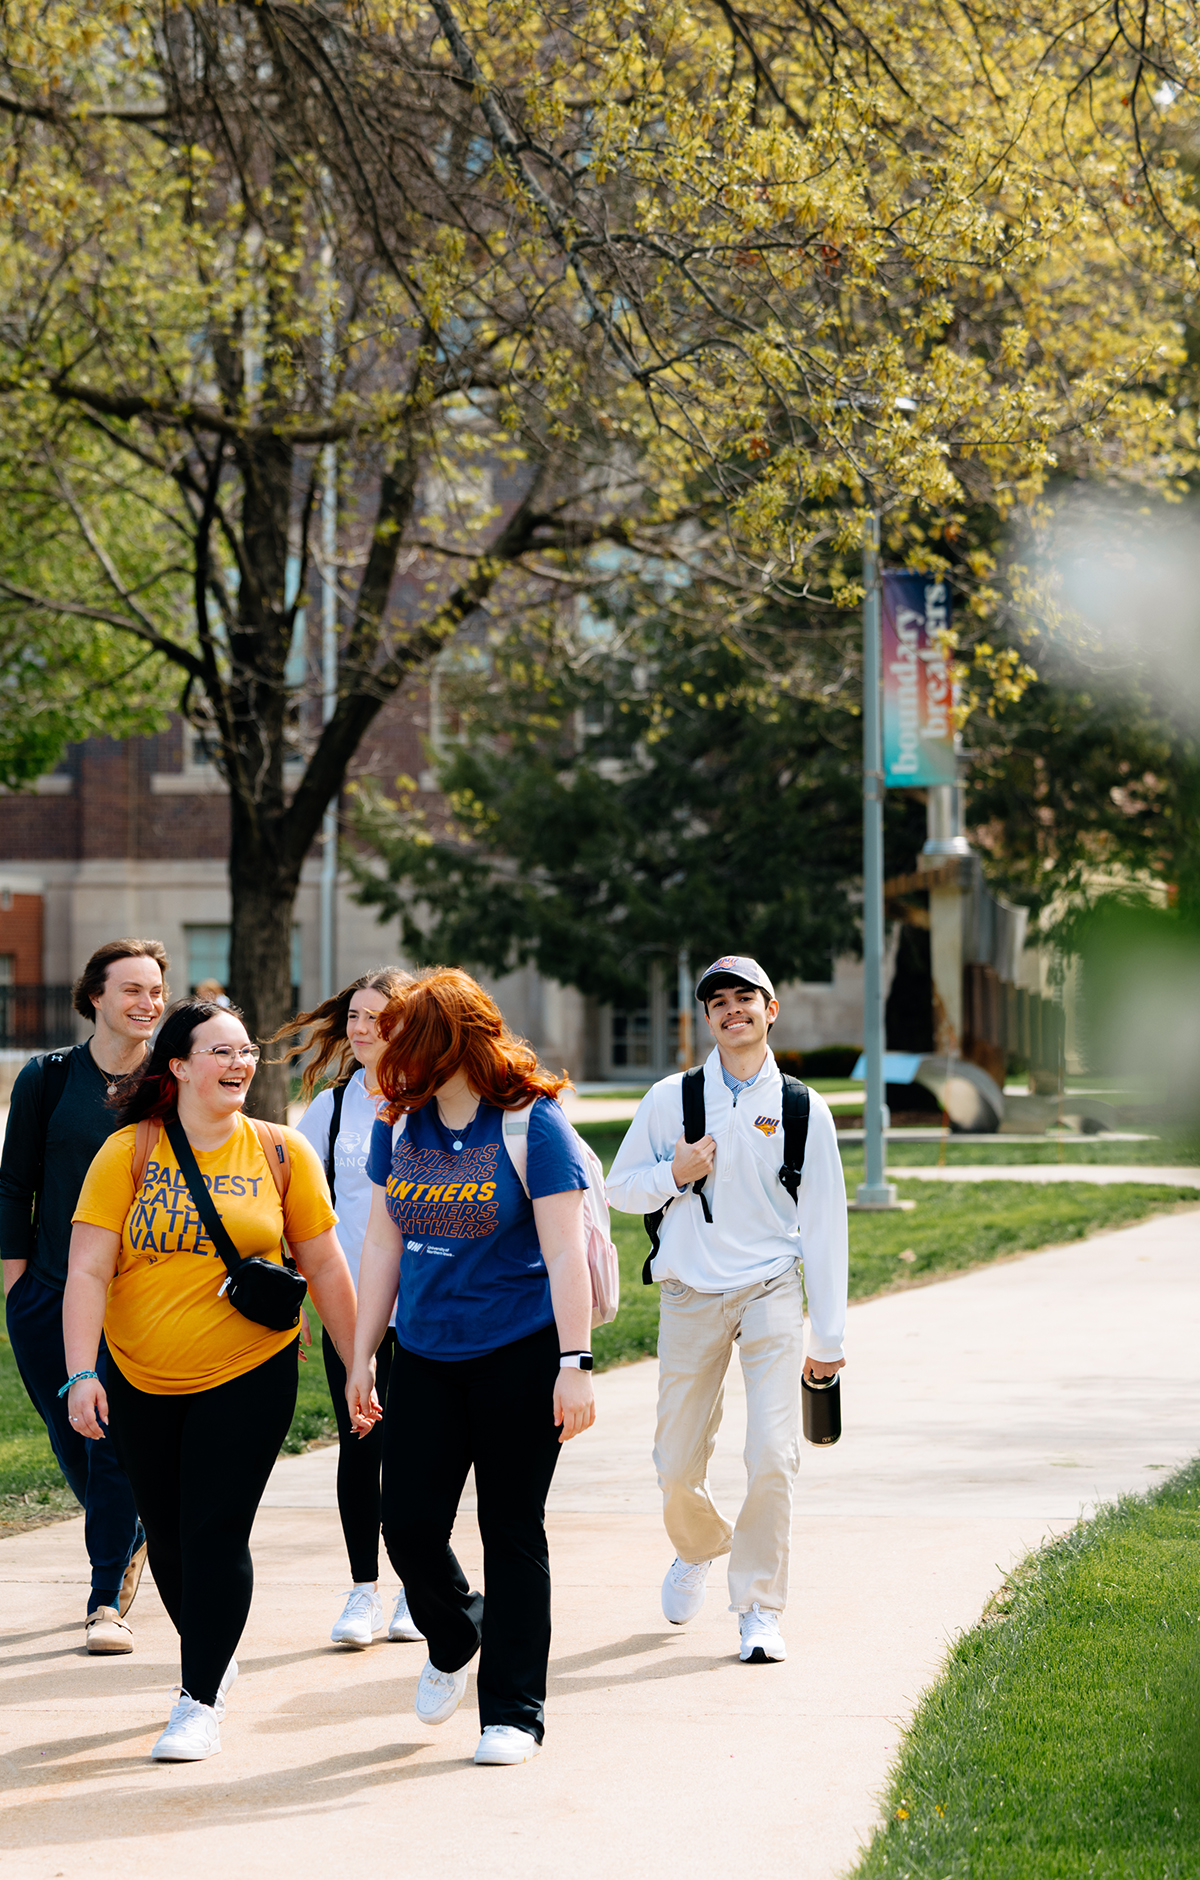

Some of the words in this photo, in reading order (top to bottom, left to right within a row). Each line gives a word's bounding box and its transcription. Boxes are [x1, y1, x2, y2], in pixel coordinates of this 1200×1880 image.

[889, 605, 925, 775] boundary
[754, 1115, 780, 1127] UNI
[334, 1156, 367, 1168] DANC
[129, 1204, 158, 1230] IN
[129, 1225, 220, 1259] VALLE
[406, 1240, 424, 1253] UNI
